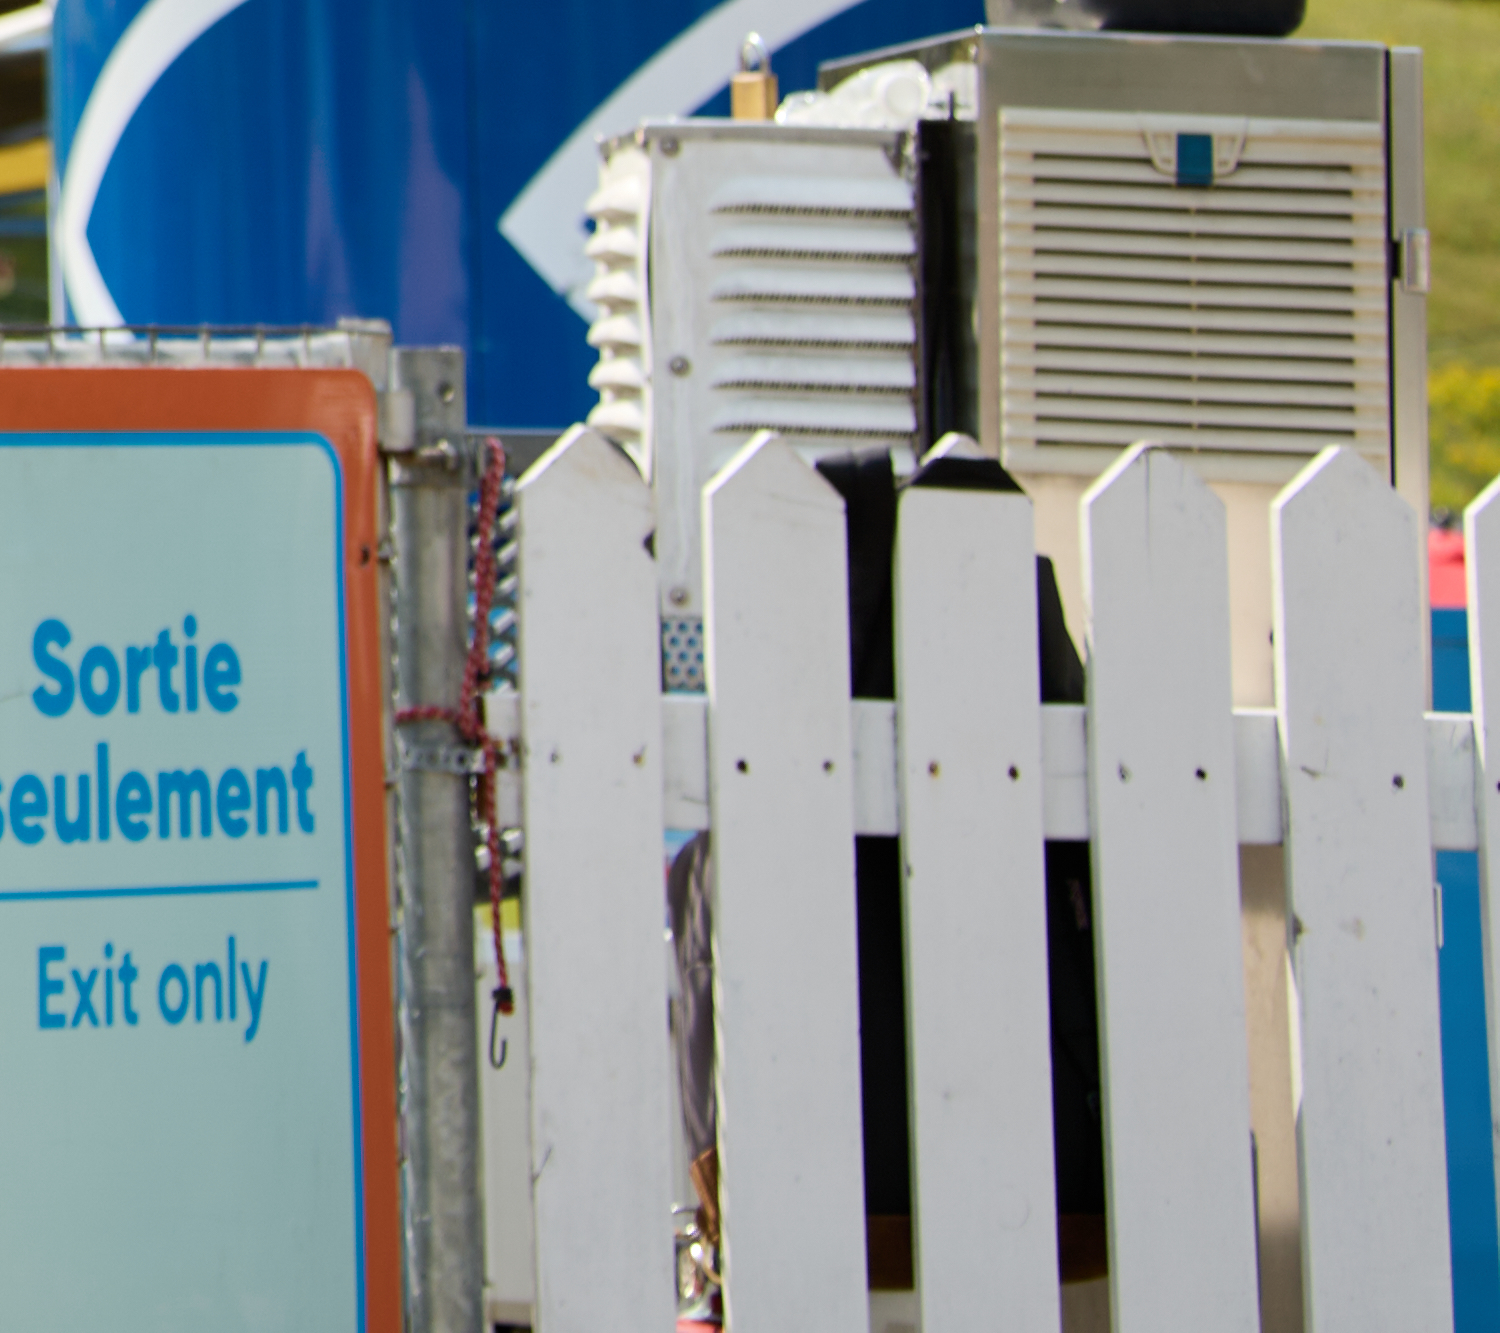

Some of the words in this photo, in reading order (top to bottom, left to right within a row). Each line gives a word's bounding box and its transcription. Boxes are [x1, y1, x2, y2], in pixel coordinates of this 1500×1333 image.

[32, 614, 242, 717] Sortie
[38, 942, 139, 1029] Exit
[158, 935, 269, 1044] only
